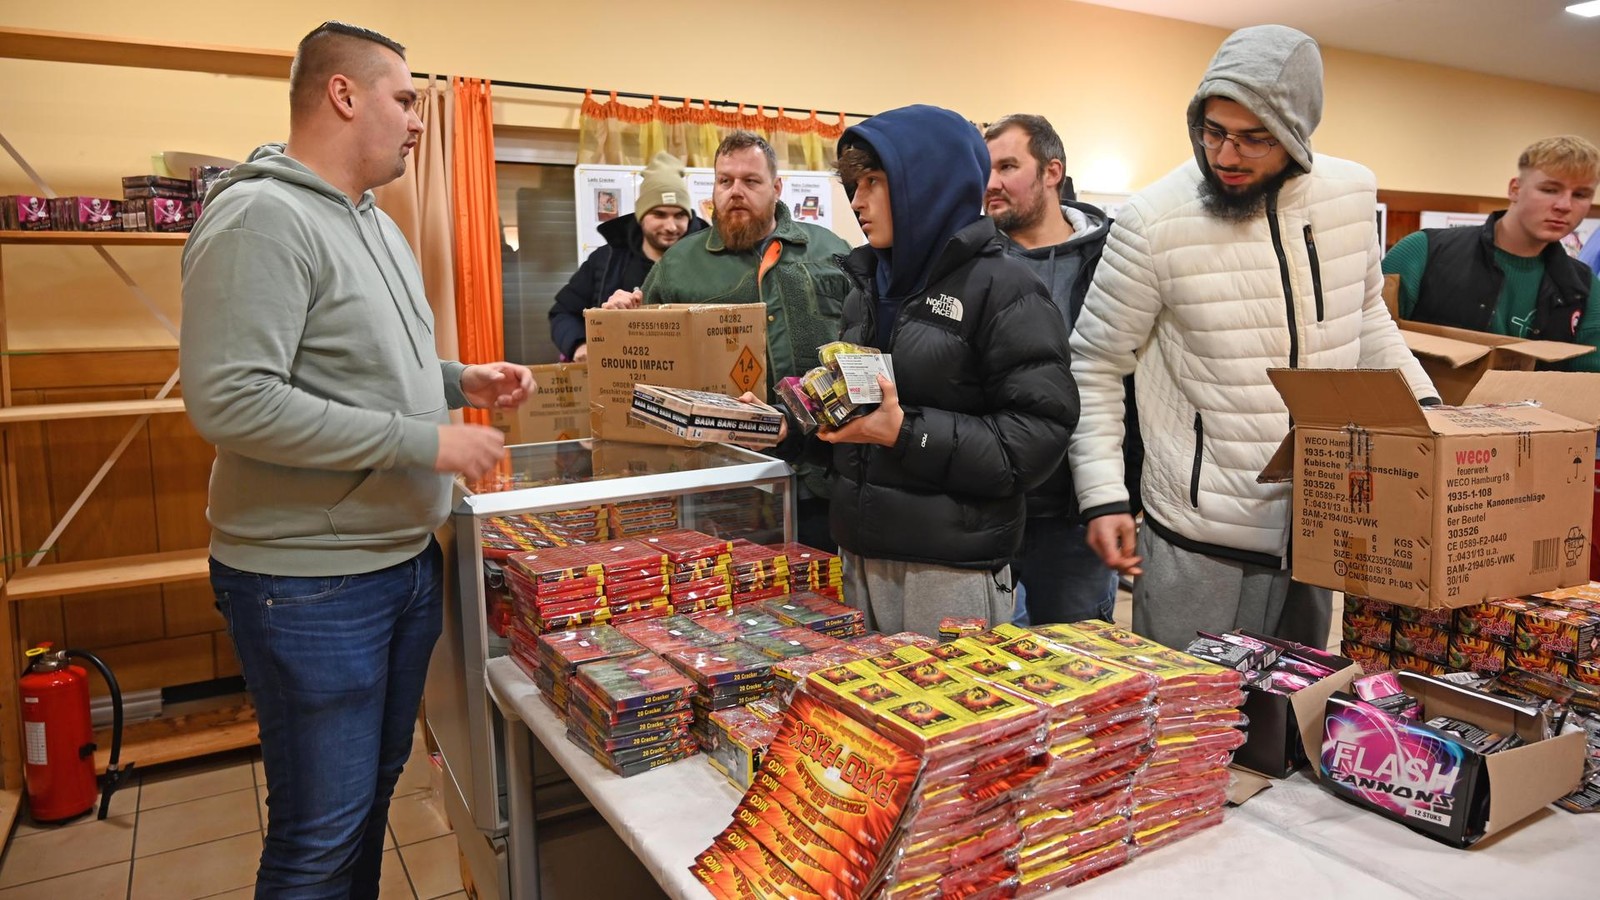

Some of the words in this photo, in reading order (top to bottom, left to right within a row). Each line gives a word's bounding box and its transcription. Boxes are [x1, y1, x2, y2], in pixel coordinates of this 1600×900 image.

[926, 297, 951, 310] NORTH
[940, 294, 954, 304] THE
[932, 305, 950, 317] FACE
[720, 314, 741, 323] 04282
[628, 322, 680, 330] 49F555/169/23
[707, 326, 731, 336] GROUND
[733, 325, 753, 334] IMPACT
[622, 346, 650, 356] 04282
[601, 358, 638, 370] GROUND
[640, 360, 674, 371] IMPACT
[739, 358, 754, 372] 1.4
[743, 375, 749, 384] G
[538, 386, 582, 395] Ausputzer
[694, 418, 715, 427] BADA
[717, 420, 737, 429] BANG
[738, 422, 757, 431] BADA
[758, 424, 779, 432] BOOM!
[1305, 437, 1328, 446] WECO
[1304, 448, 1350, 459] 1935-1-108
[1304, 458, 1340, 469] Kubische
[1457, 465, 1488, 475] feuerwerk
[1304, 468, 1316, 477] 6er
[1318, 471, 1343, 480] Beutel
[1471, 474, 1502, 485] Hamburg
[1502, 473, 1510, 481] 18
[1303, 479, 1335, 490] 303526
[1304, 489, 1314, 497] CE
[1448, 488, 1492, 501] 1935-1-108
[1447, 502, 1483, 514] Kubische
[1487, 493, 1545, 508] Kanonenschläge
[1301, 518, 1323, 528] 30/1/6
[1303, 508, 1378, 528] BAM-2194/05-VWK
[1448, 517, 1459, 526] 6er
[1462, 513, 1486, 523] Beutel
[1303, 529, 1314, 538] 221
[1394, 538, 1413, 548] KGS
[1448, 526, 1479, 539] 303526
[1447, 542, 1458, 551] CE
[1460, 533, 1507, 549] 0589-F2-0440
[1394, 549, 1412, 559] KGS
[1486, 548, 1498, 556] u.a.
[1334, 549, 1352, 560] SIZE:
[1355, 552, 1412, 570] 435X235X260MM
[1447, 554, 1515, 575] BAM-2194/05-VWK
[1348, 562, 1392, 575] 4G/Y10/S/18
[1349, 572, 1385, 585] CN/360502
[1447, 573, 1469, 586] 30/1/6
[1448, 587, 1460, 596] 221
[741, 671, 758, 680] Cracker
[746, 683, 762, 691] Cracker
[745, 694, 760, 702] Cracker
[641, 735, 658, 743] Cracker
[650, 746, 666, 754] Cracker
[657, 757, 672, 765] Cracker
[788, 720, 898, 808] PYRO-PACK
[1332, 740, 1461, 793] FLASH
[768, 760, 788, 777] NICO
[760, 774, 781, 791] NICO
[810, 781, 830, 808] 60
[1328, 770, 1455, 811] CANNONS
[751, 794, 770, 812] NICO
[740, 809, 759, 827] NICO
[1414, 808, 1421, 817] 12
[1423, 810, 1442, 822] STUKS
[728, 832, 748, 850] NICO
[703, 855, 724, 874] NICO
